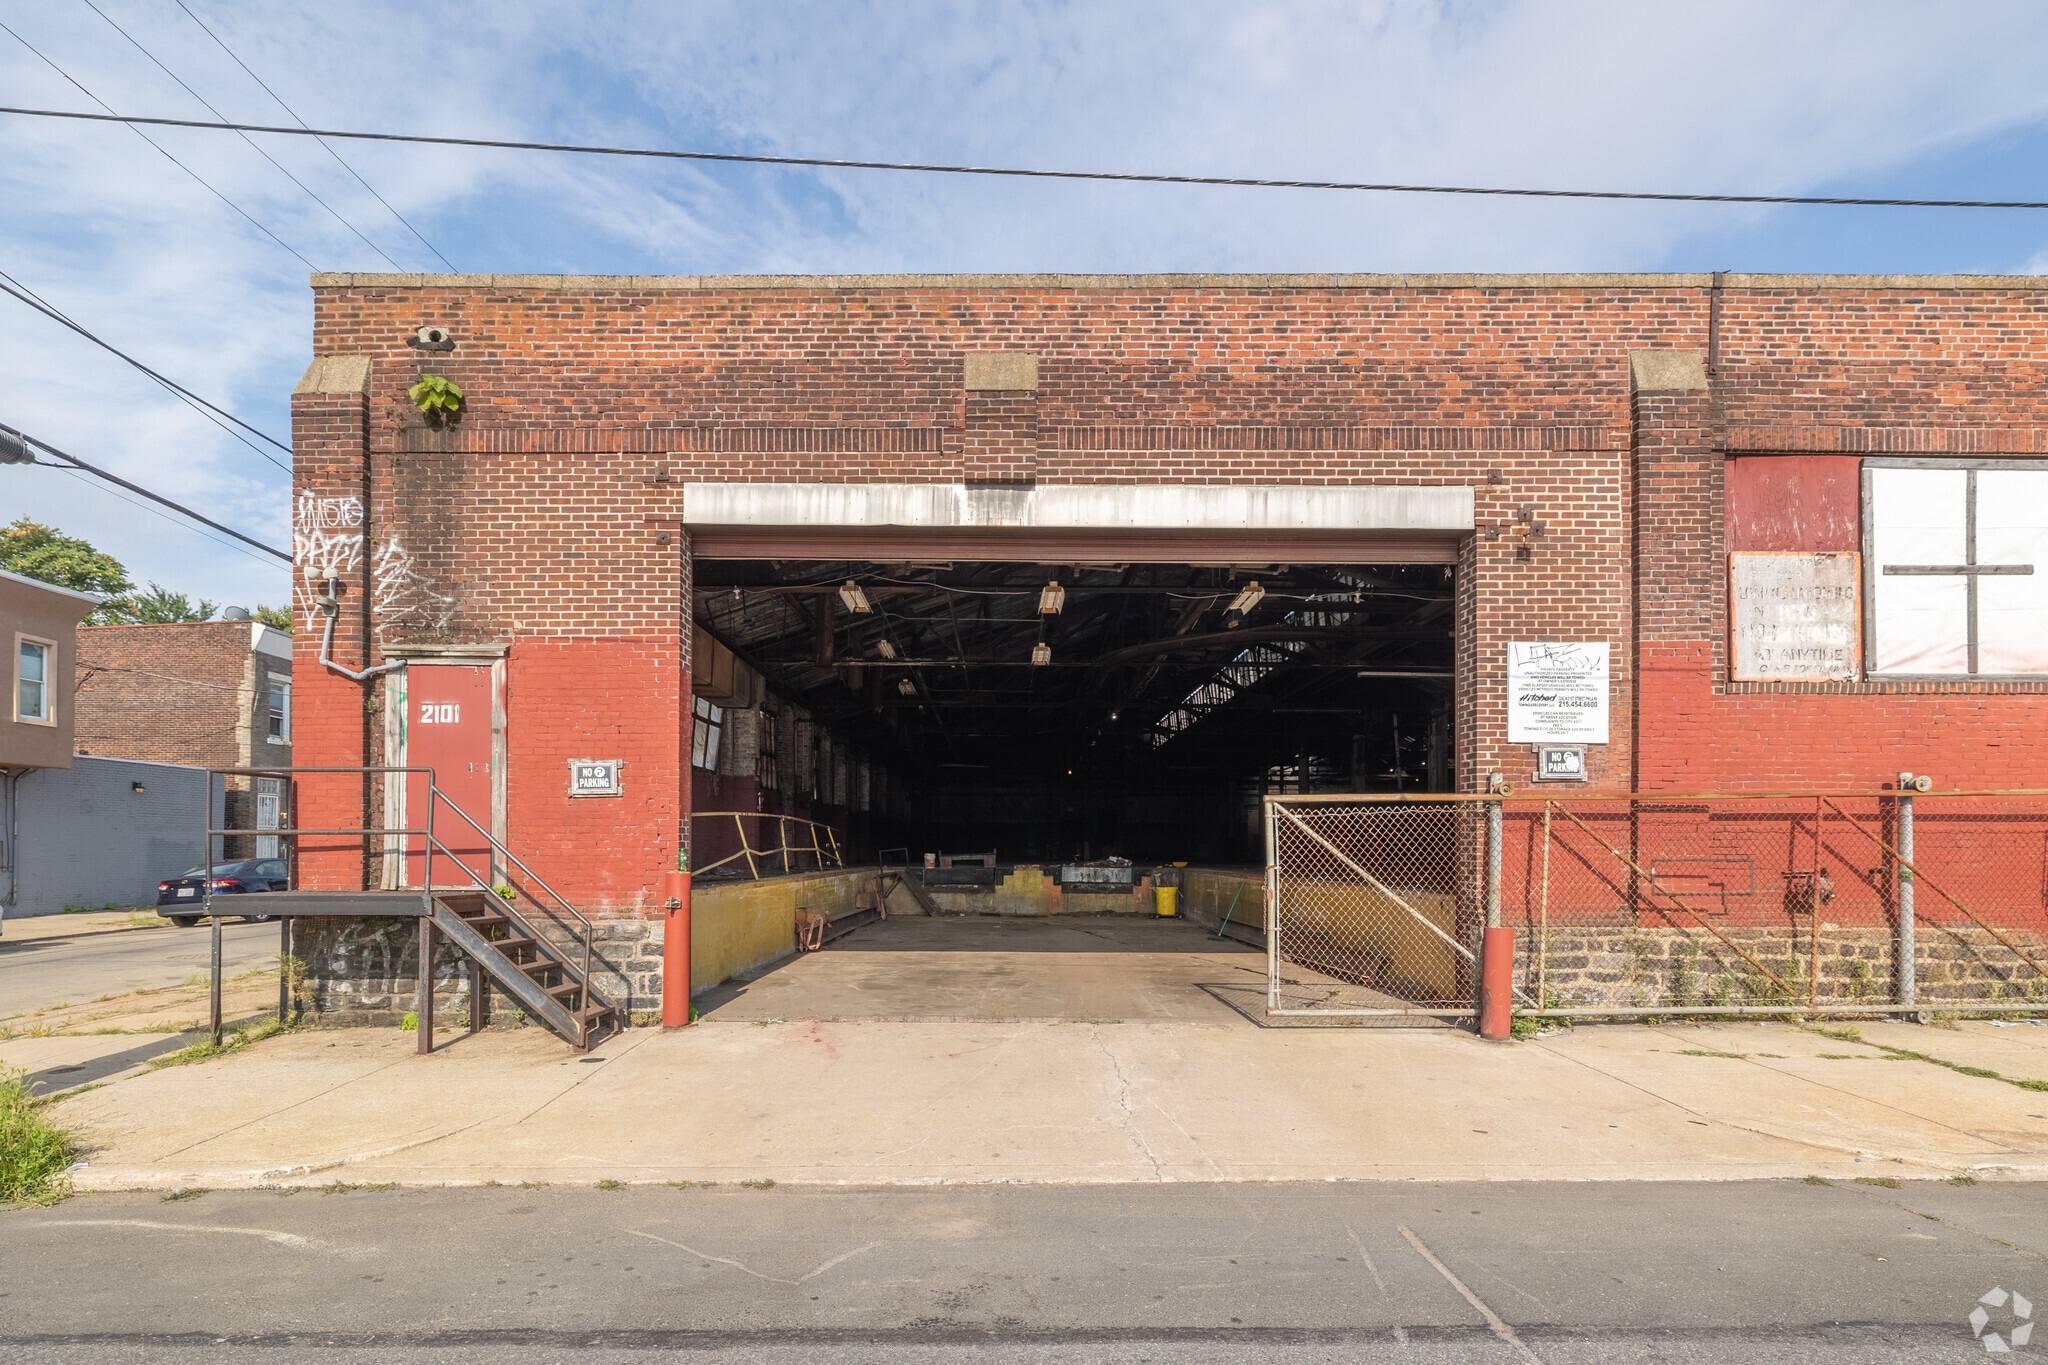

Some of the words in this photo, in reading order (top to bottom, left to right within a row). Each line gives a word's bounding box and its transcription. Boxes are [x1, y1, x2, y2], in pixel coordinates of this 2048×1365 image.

[1519, 693, 1557, 702] Hitched
[421, 704, 460, 724] 2101
[1551, 752, 1562, 762] NO
[582, 767, 593, 778] NO
[1548, 762, 1578, 773] PARK
[579, 778, 609, 788] PARKING
